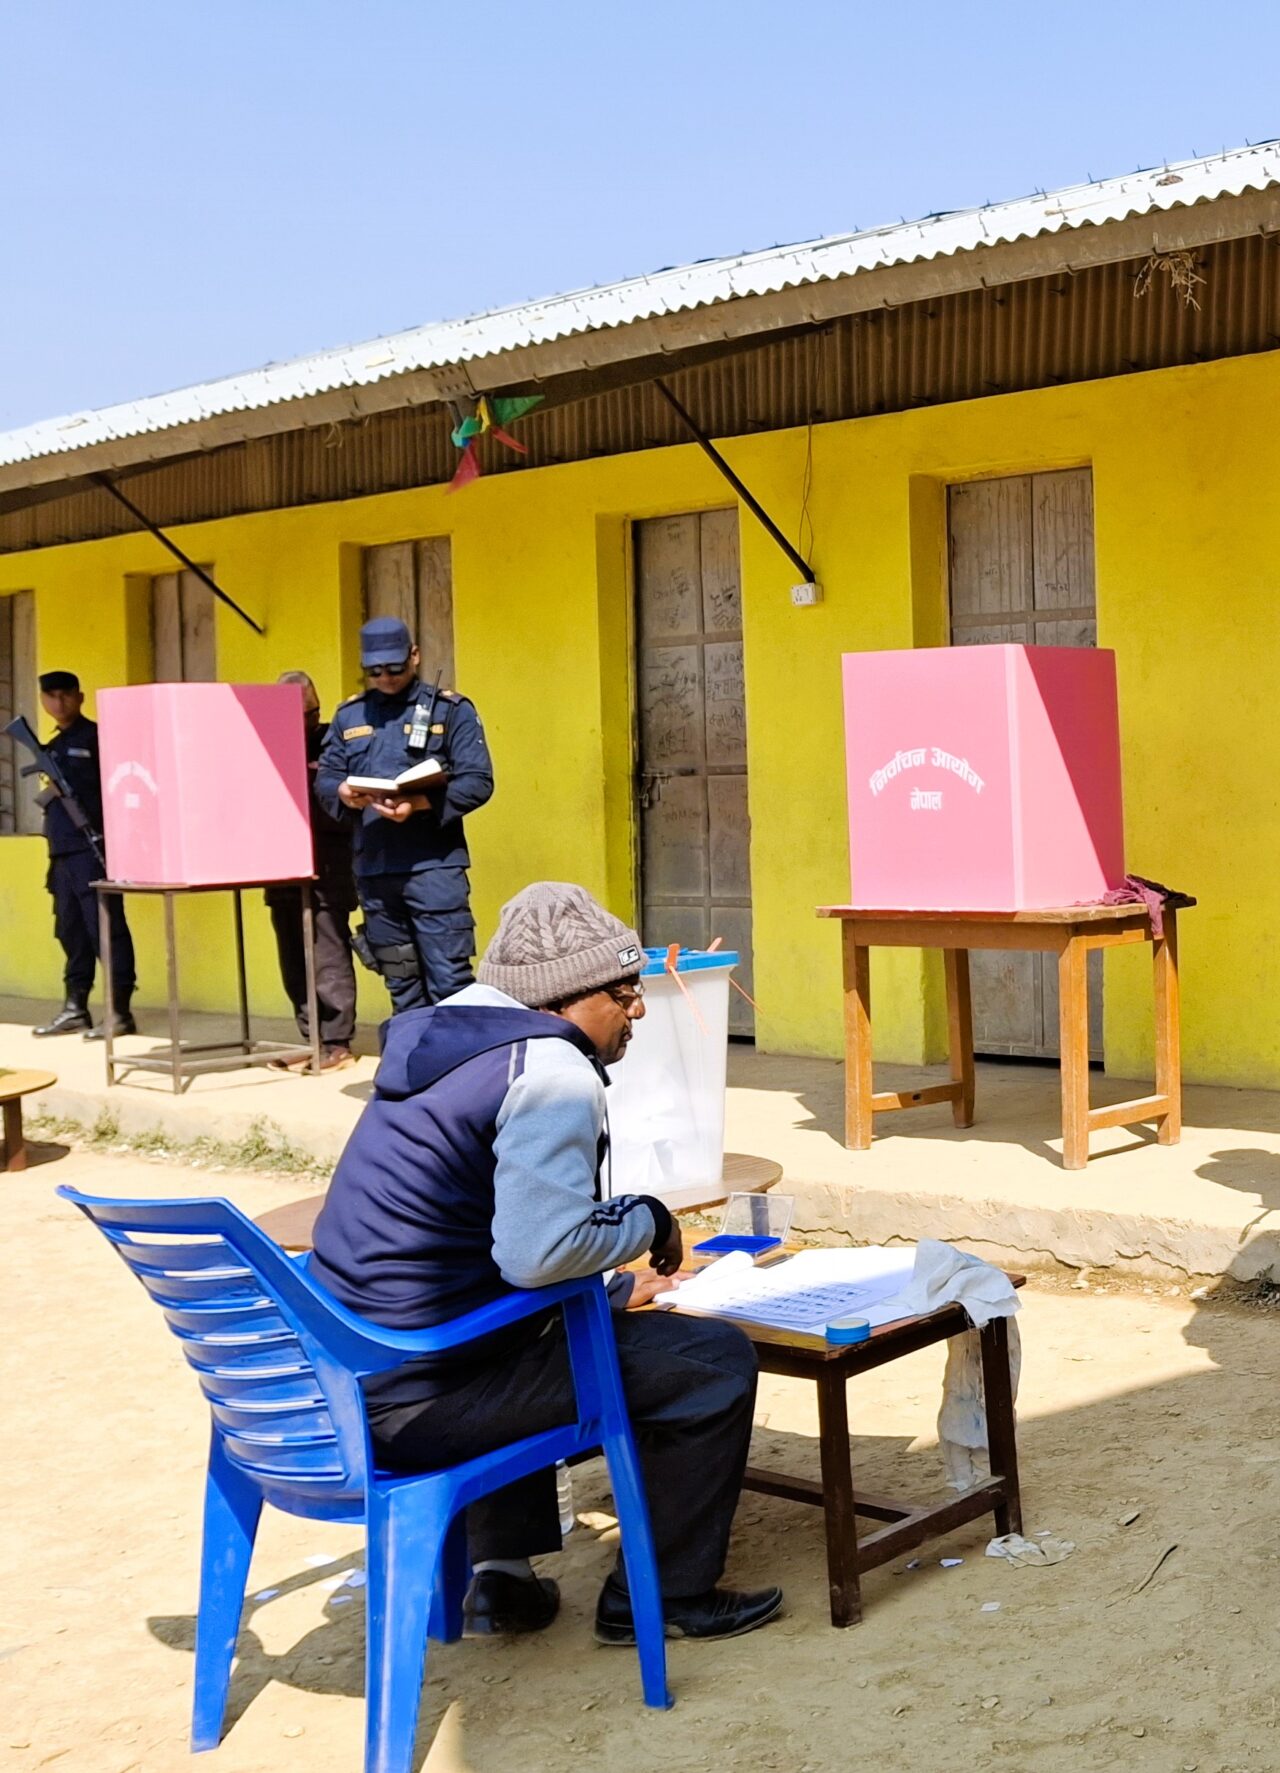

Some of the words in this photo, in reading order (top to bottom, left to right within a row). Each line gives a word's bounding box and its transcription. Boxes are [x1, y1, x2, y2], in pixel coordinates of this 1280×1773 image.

[869, 748, 926, 797] निर्वाचन
[931, 747, 985, 795] आयोग
[910, 787, 942, 811] नेपाल
